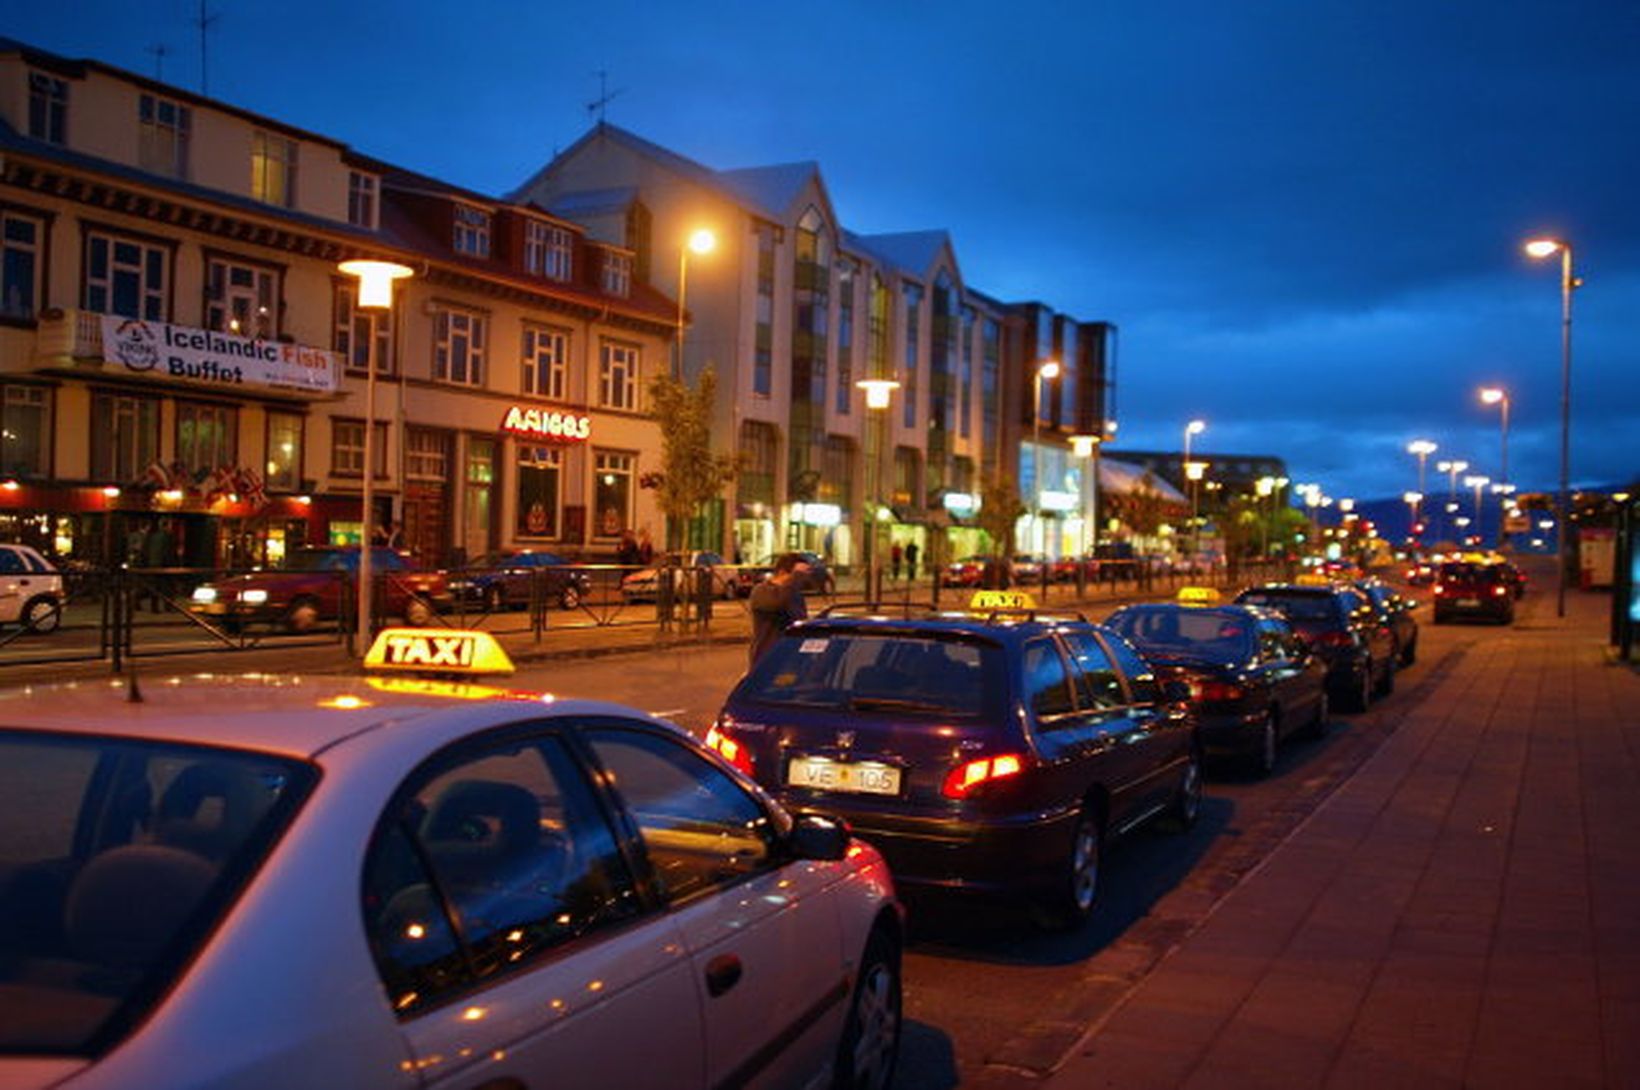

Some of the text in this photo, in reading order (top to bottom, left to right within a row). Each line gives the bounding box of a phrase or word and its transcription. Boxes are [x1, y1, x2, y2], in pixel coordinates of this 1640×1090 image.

[165, 326, 328, 370] Icelandic Fish
[168, 357, 244, 384] Buffet
[503, 406, 591, 439] AMIGOS
[387, 636, 472, 665] TAXI
